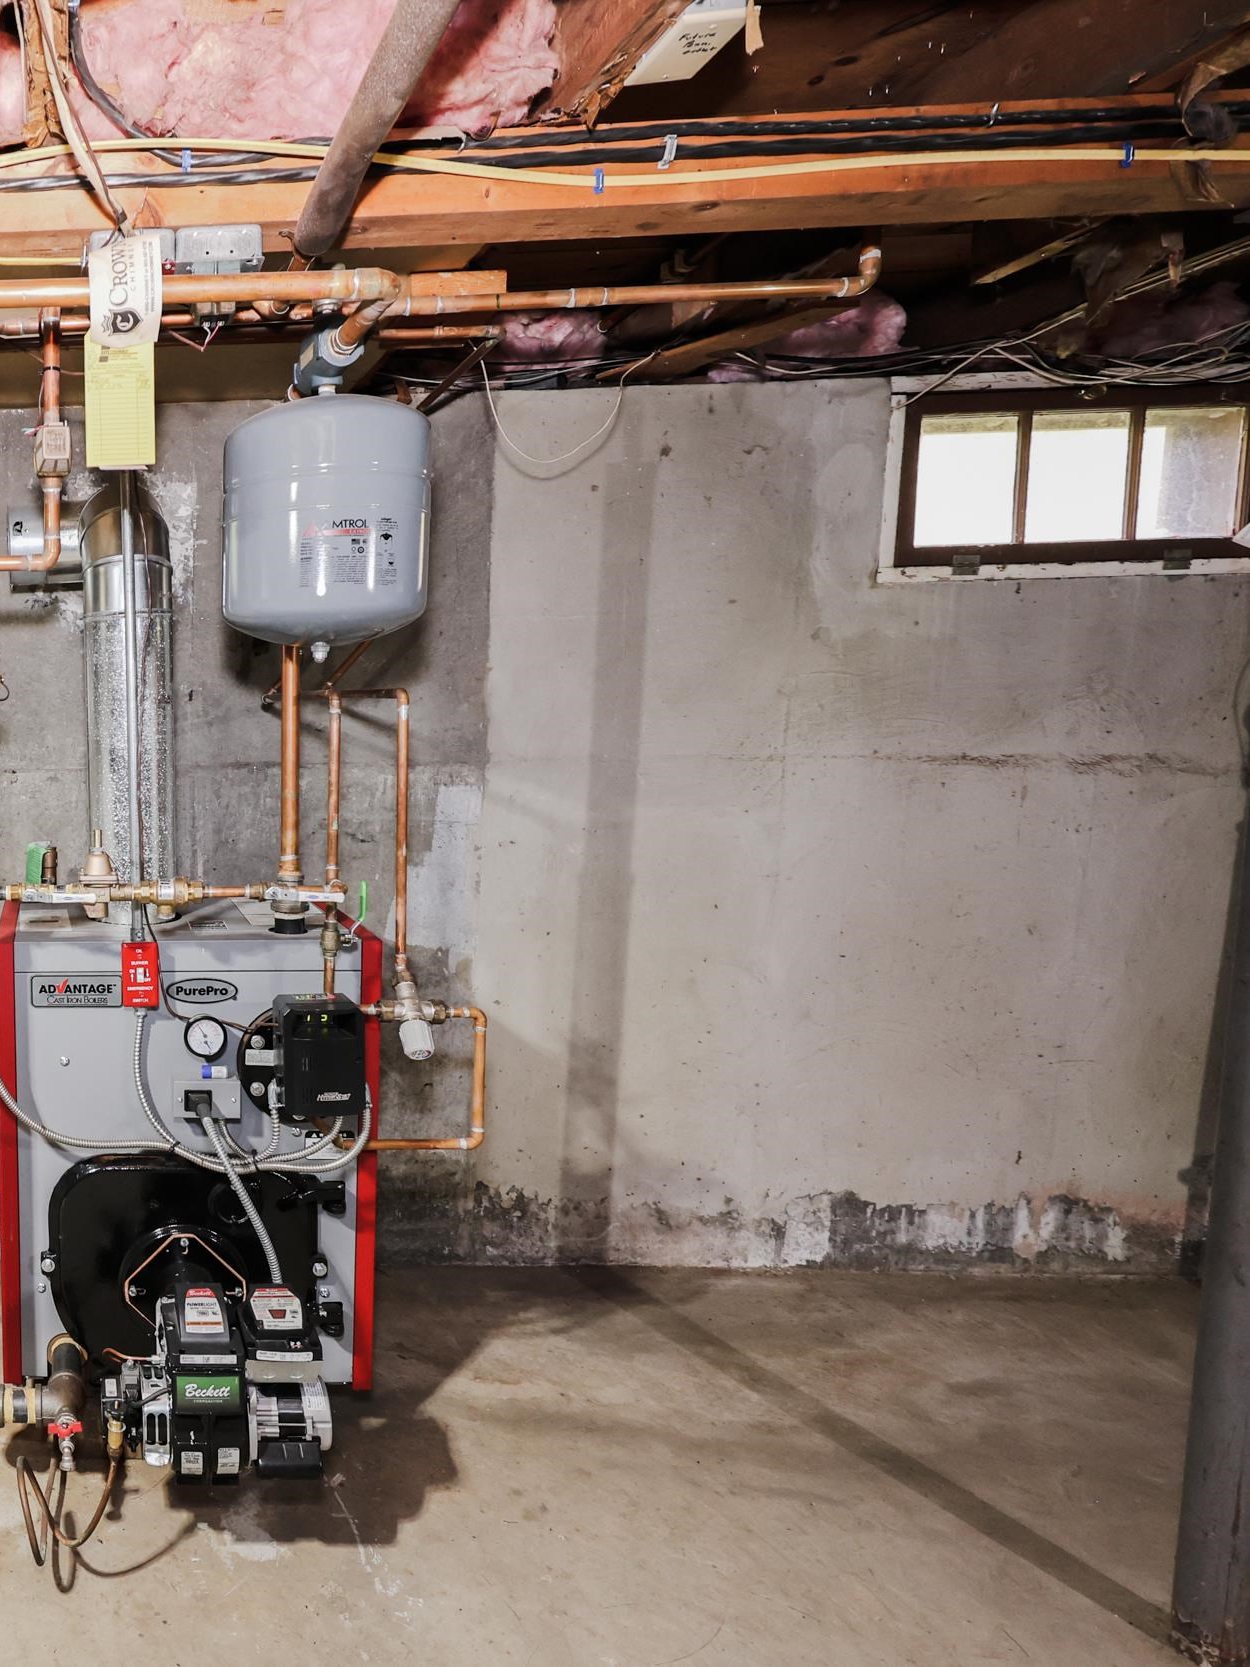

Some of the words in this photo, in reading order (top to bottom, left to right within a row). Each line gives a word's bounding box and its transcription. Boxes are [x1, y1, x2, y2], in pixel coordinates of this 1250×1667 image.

[38, 978, 112, 995] ADVANTAGE
[175, 985, 229, 997] PurePro
[184, 1383, 231, 1398] Beckett
